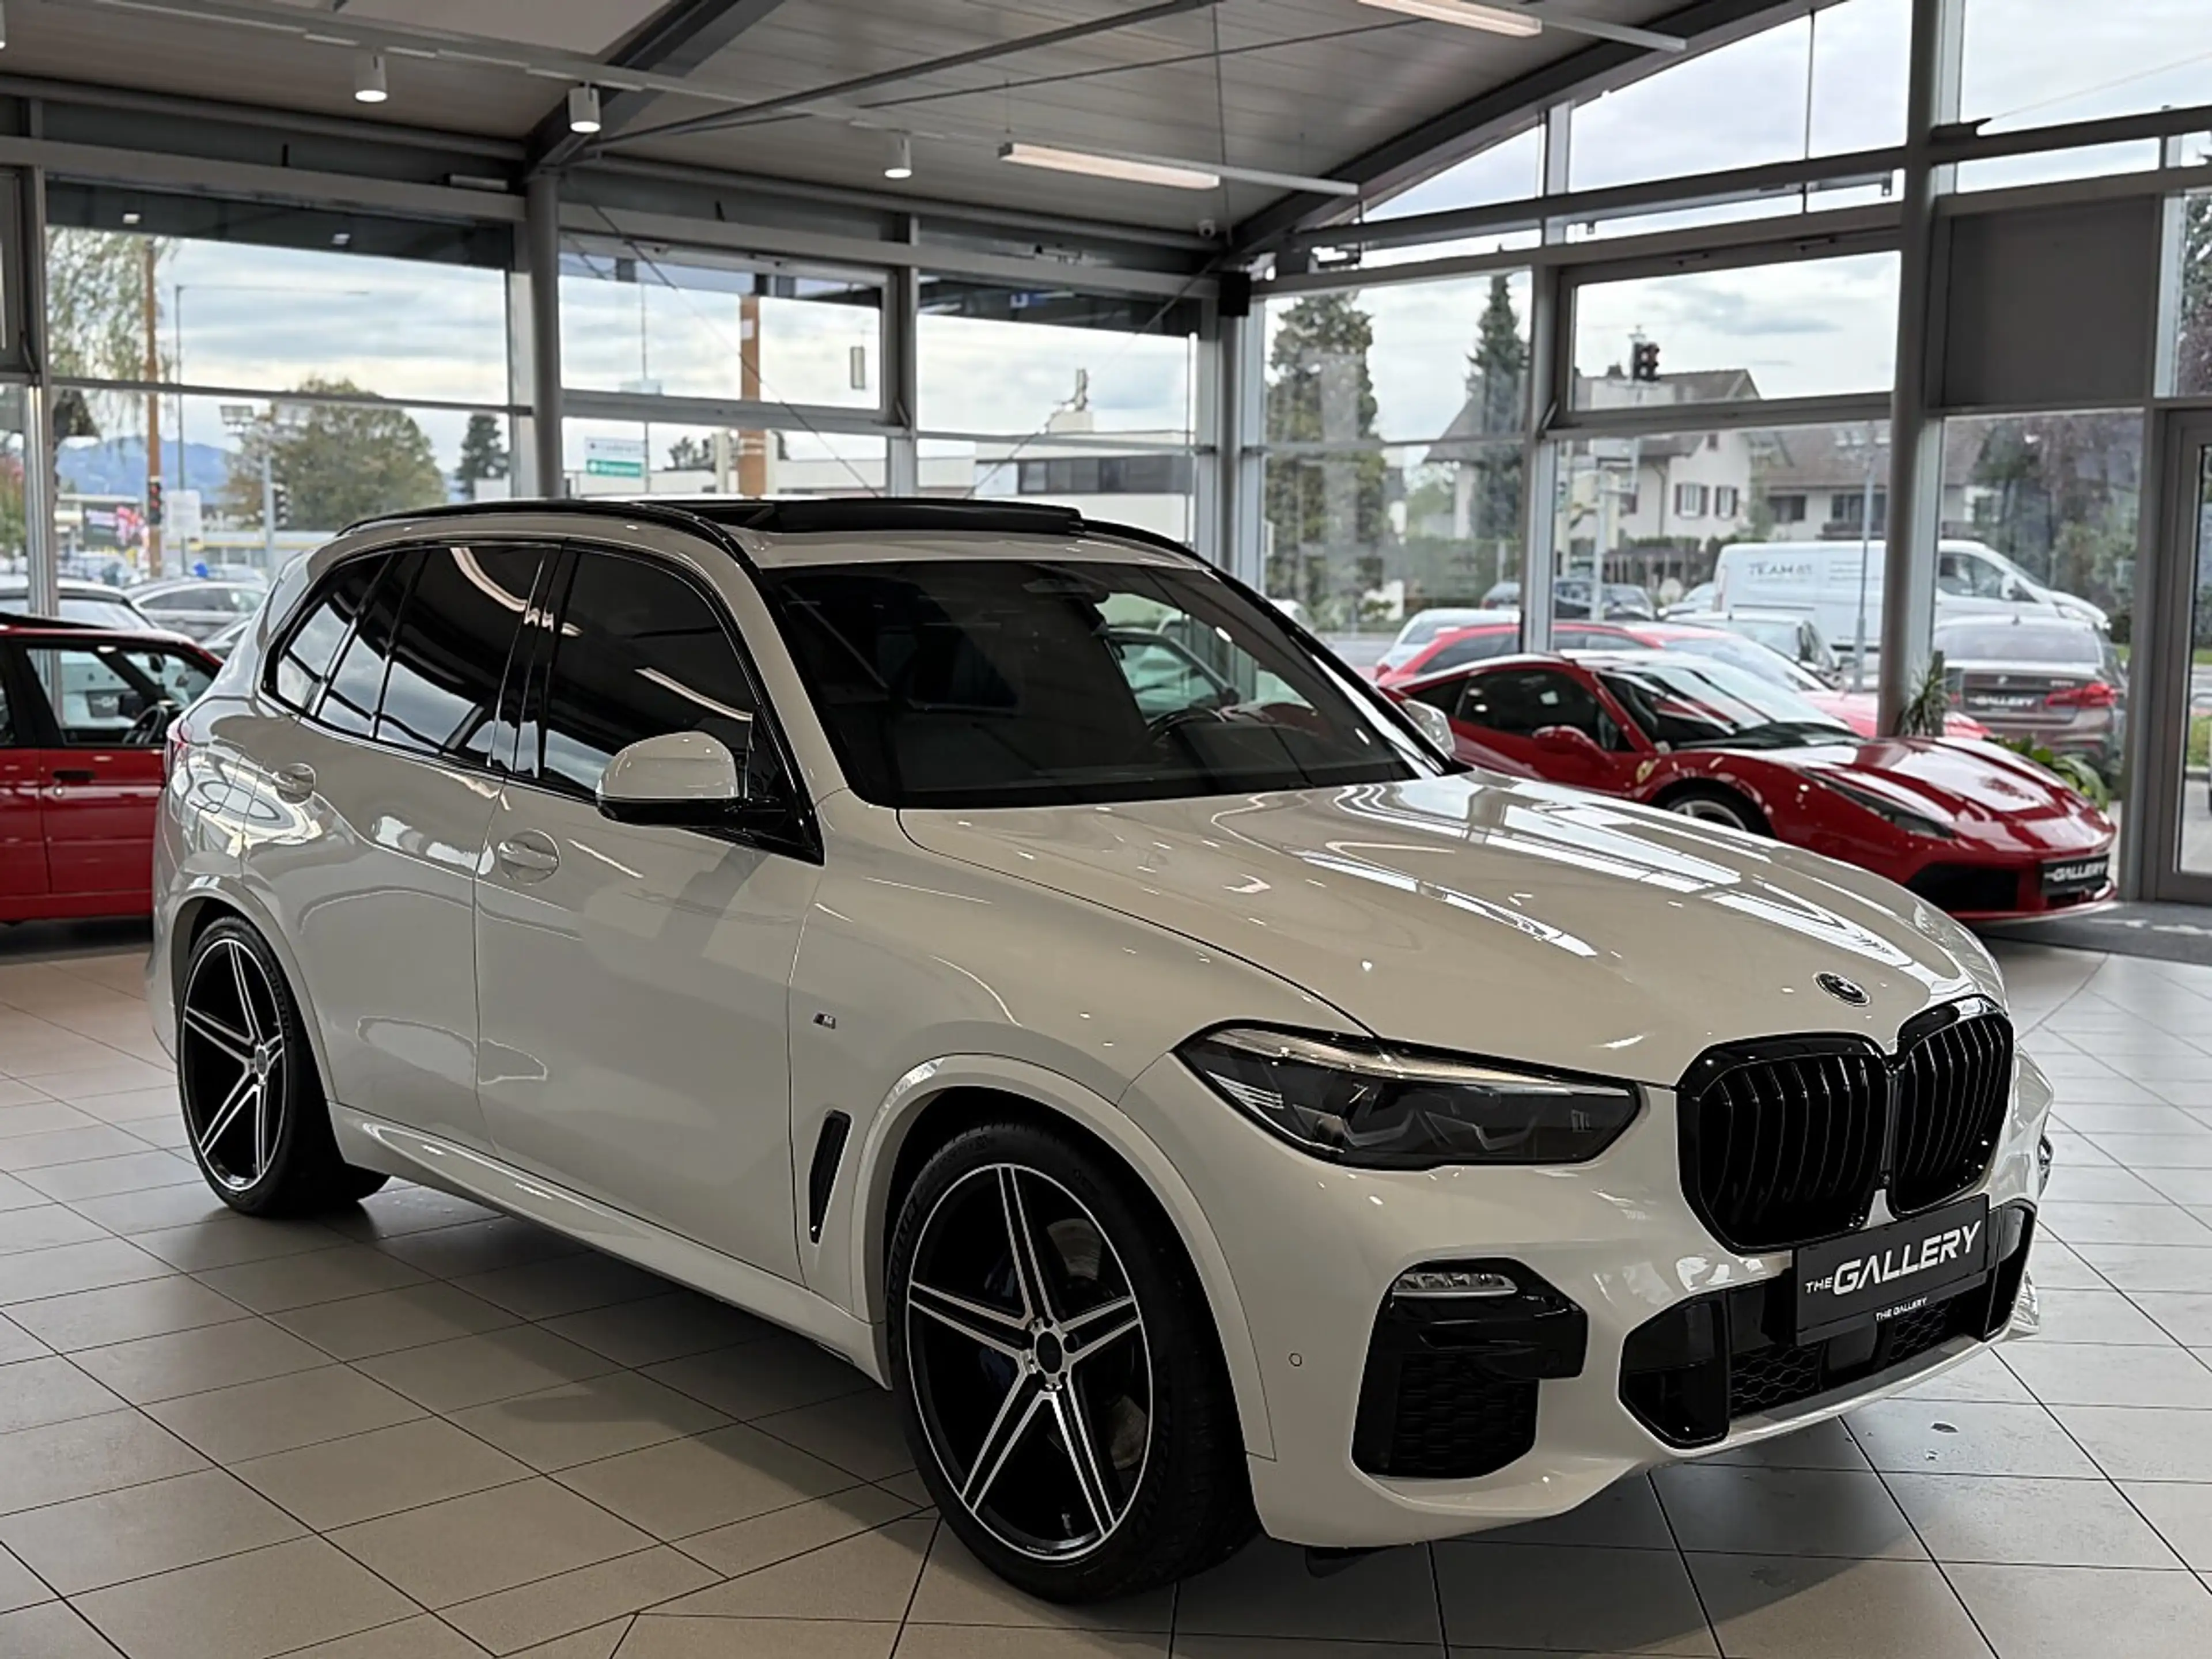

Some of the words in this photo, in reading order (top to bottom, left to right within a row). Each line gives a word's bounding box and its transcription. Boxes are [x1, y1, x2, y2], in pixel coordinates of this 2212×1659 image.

[1805, 1276, 1833, 1294] THE
[1833, 1220, 1982, 1296] GALLERY
[1875, 1308, 1893, 1321] THE
[1893, 1297, 1928, 1316] GALLERY
